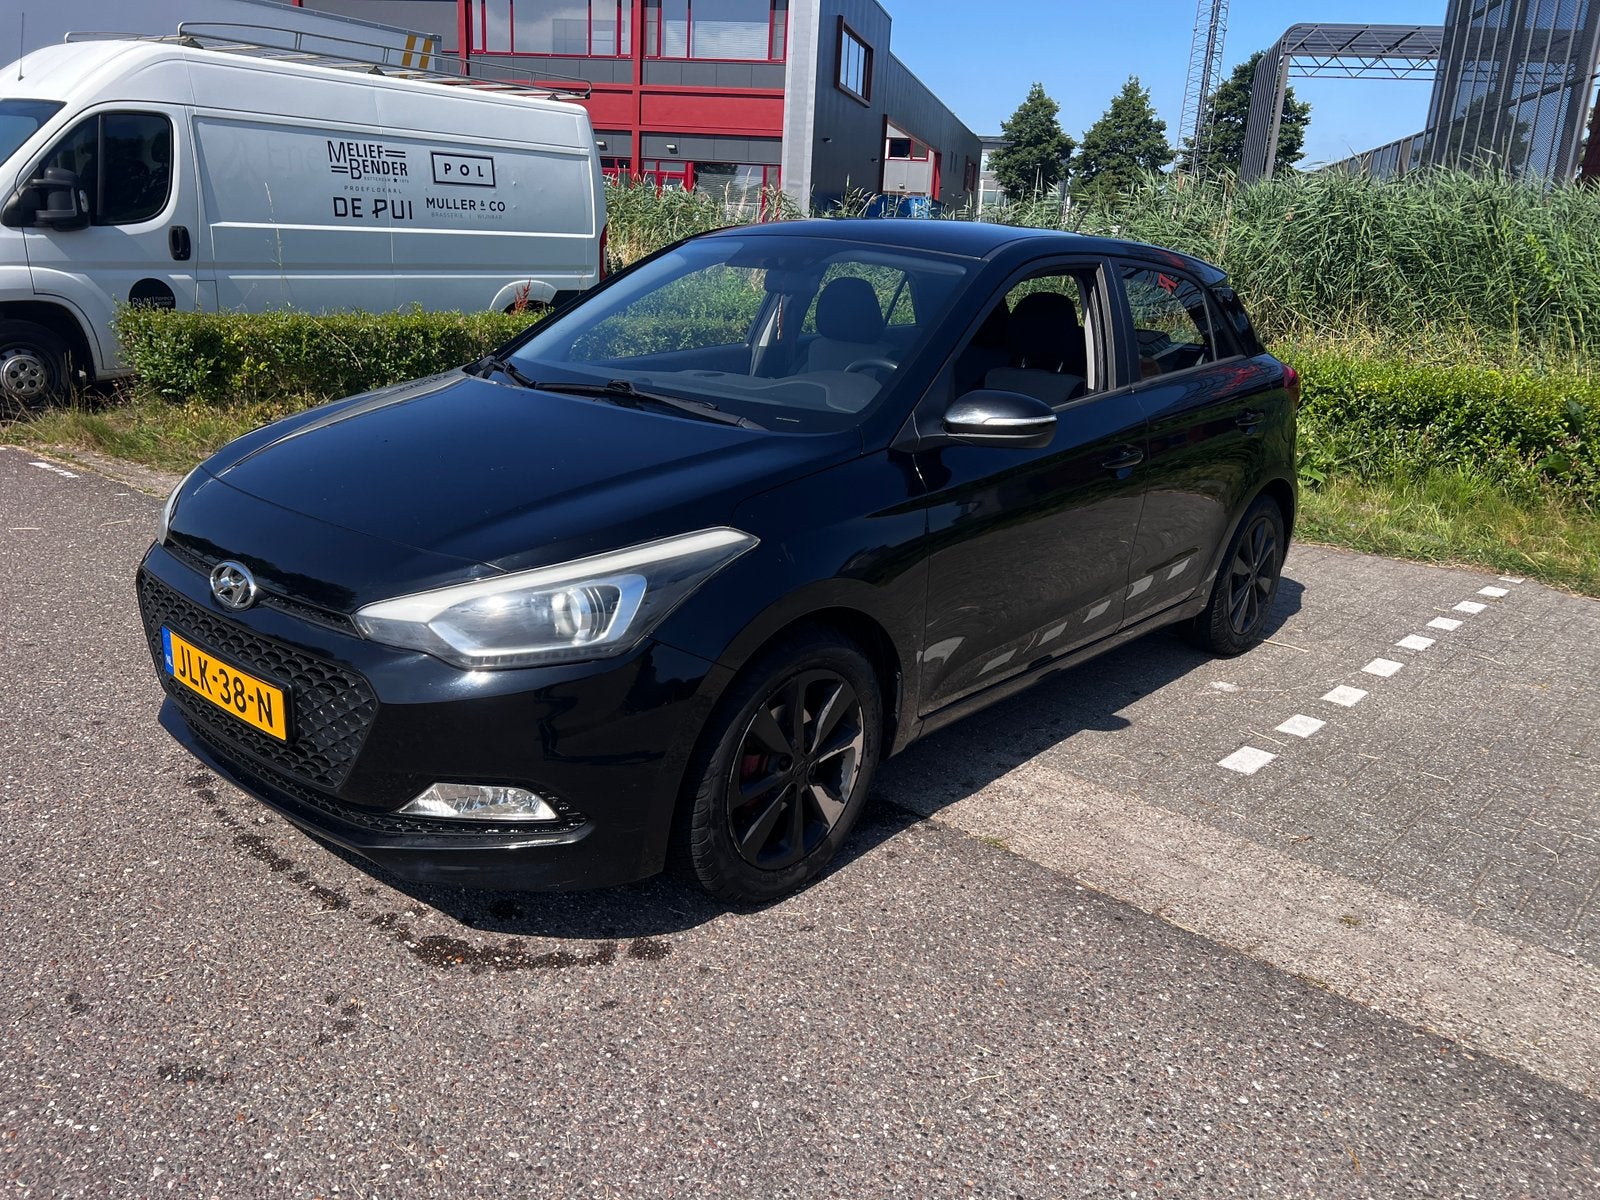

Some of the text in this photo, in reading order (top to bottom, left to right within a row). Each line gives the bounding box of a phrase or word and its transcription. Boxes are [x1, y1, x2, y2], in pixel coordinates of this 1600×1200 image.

[327, 140, 383, 163] MELIEF
[348, 158, 408, 180] BENDER
[443, 163, 484, 177] POL
[344, 185, 403, 194] PROEFLOKAAL
[333, 196, 413, 220] DE PUI
[426, 197, 477, 211] MULLER
[489, 201, 506, 212] CO
[178, 645, 274, 728] JLK-38-N
